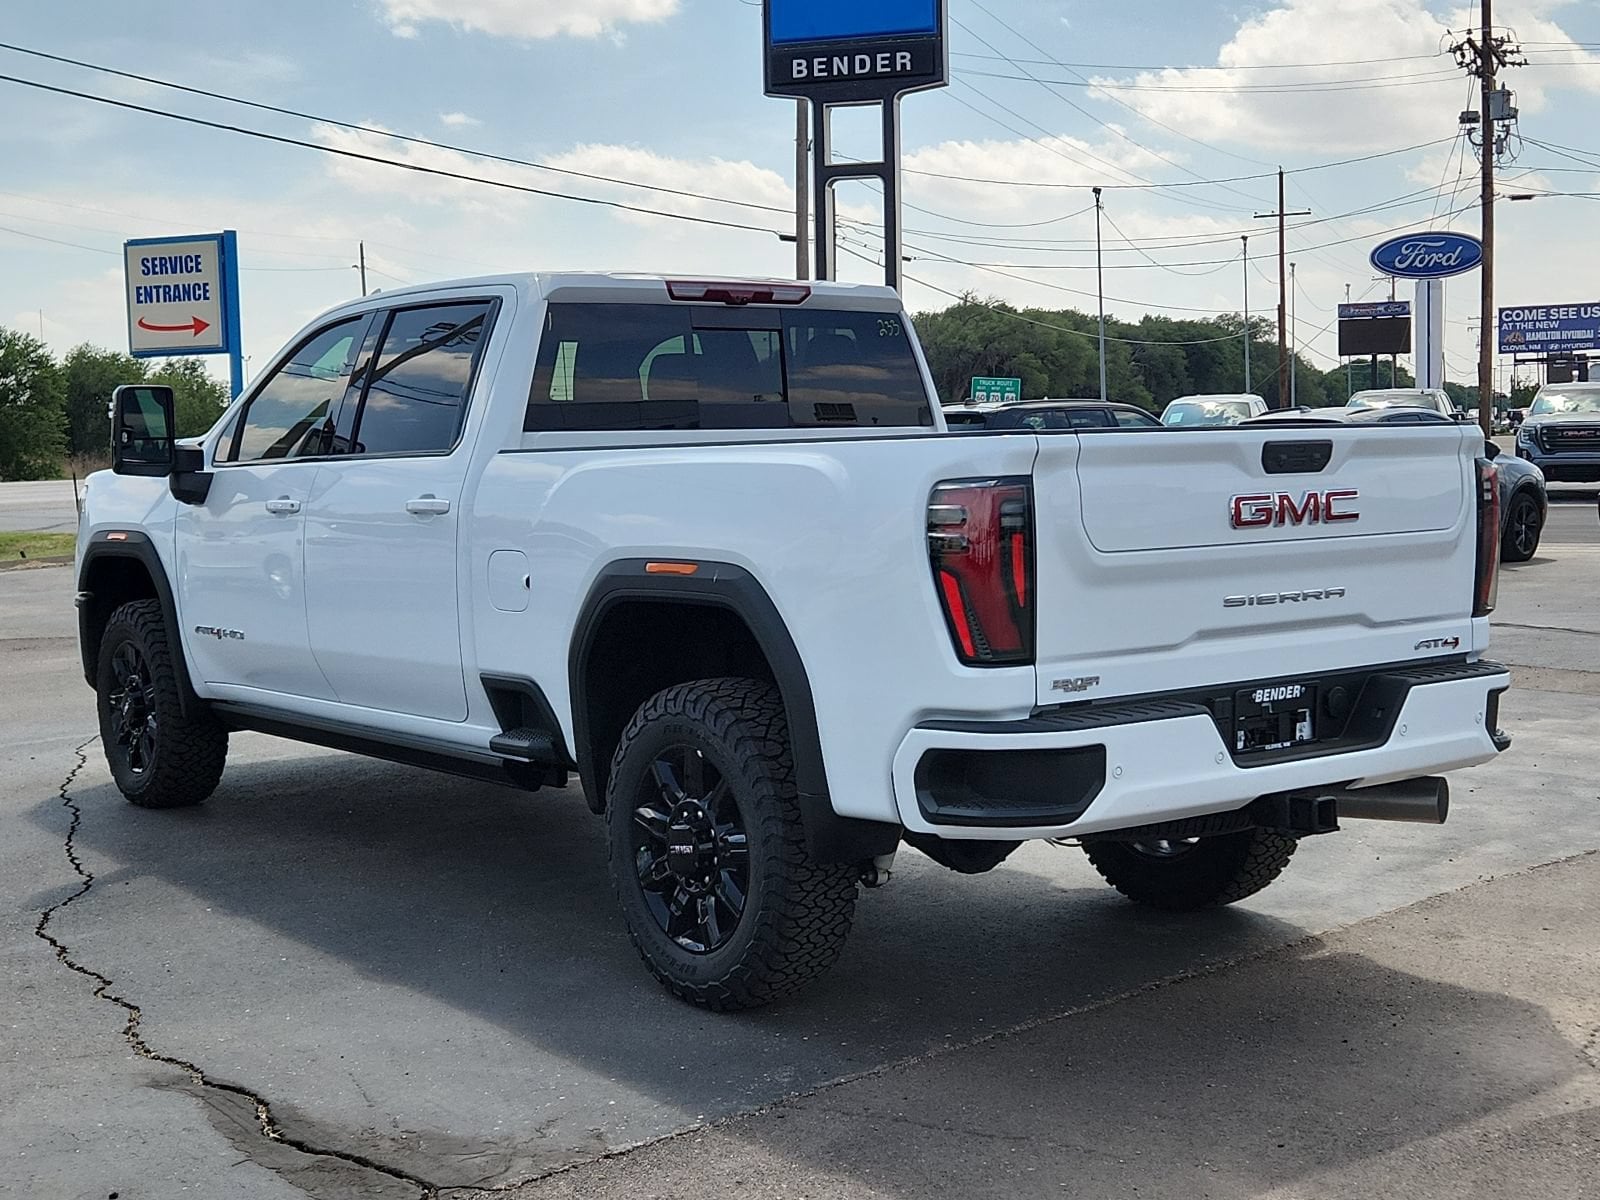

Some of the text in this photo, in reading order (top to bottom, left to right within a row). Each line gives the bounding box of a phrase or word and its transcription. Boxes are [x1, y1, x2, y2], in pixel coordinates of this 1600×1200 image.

[792, 52, 912, 78] BENDER
[1395, 241, 1462, 268] Ford
[141, 255, 202, 276] SERVICE
[135, 282, 210, 304] ENTRANCE
[1501, 306, 1600, 321] COME SEE US
[1502, 321, 1560, 330] AT THE NEW
[1526, 330, 1594, 341] HAMILTON HYUNDAI
[1229, 488, 1360, 529] GMC
[1223, 587, 1346, 607] SIERRA
[1414, 636, 1460, 650] AT4
[1254, 685, 1302, 703] BENDER
